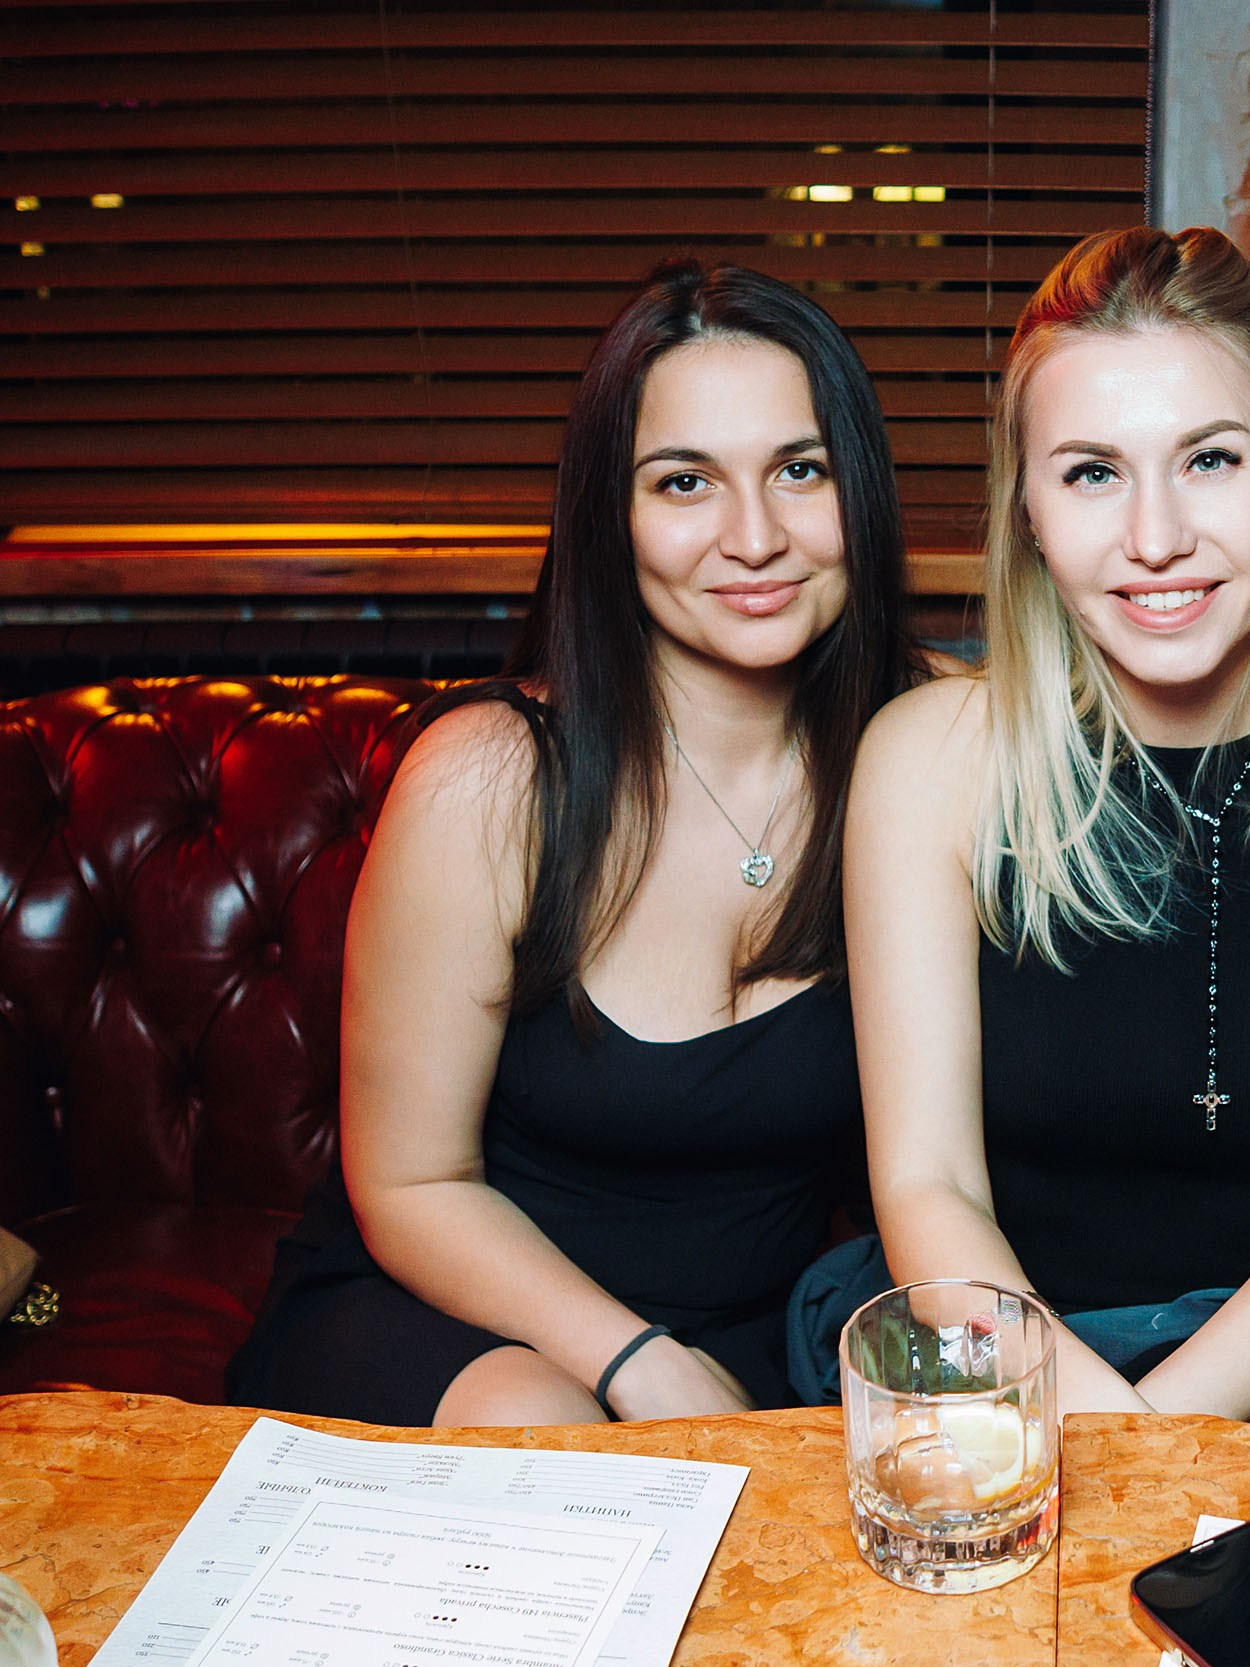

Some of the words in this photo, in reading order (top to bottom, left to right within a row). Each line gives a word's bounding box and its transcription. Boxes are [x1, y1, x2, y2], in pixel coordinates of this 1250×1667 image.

[314, 1476, 388, 1493] КОКТЕЙЛИ
[562, 1504, 631, 1518] НАПИТКИ
[439, 1596, 478, 1609] privada
[479, 1602, 520, 1615] Cosecha
[522, 1608, 539, 1617] 149
[540, 1609, 589, 1623] Plasencia
[392, 1642, 446, 1657] Grandioso
